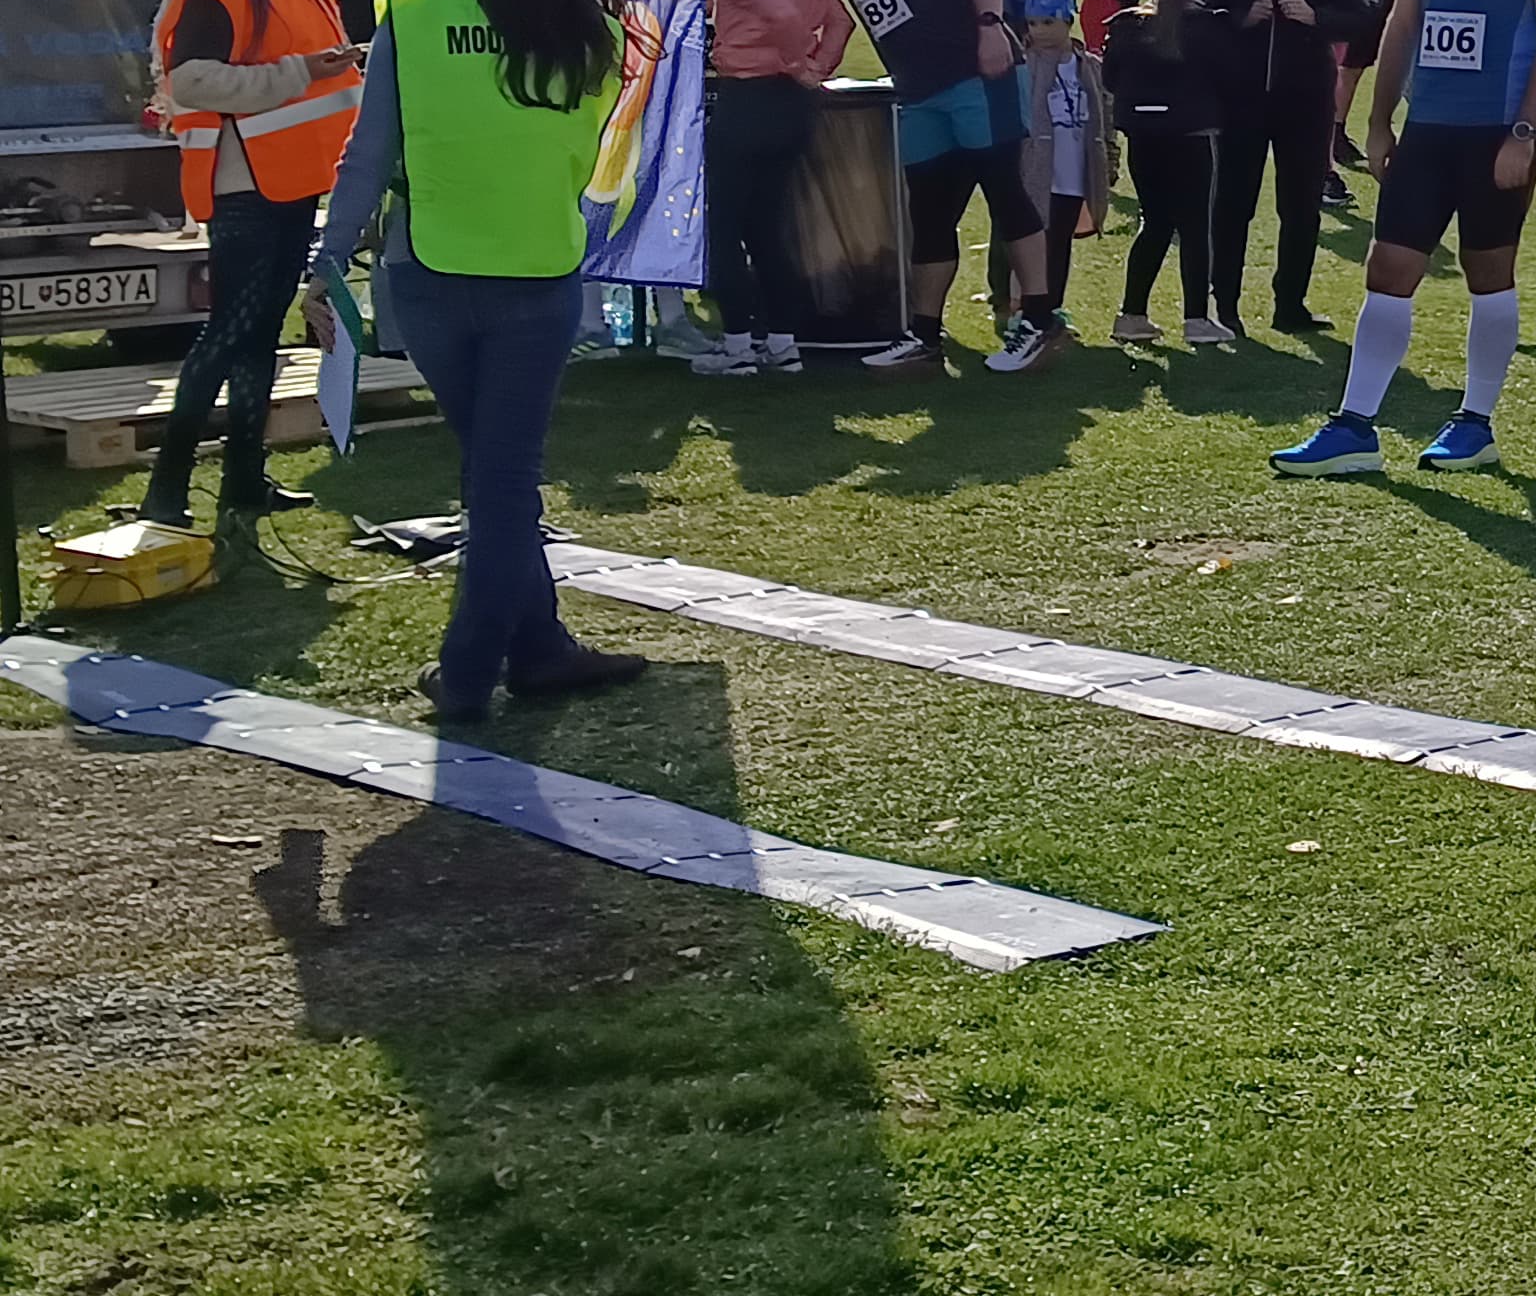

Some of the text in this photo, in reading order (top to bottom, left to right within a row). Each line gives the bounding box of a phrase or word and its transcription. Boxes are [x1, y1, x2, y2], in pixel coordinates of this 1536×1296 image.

[446, 25, 505, 54] MOD
[1424, 24, 1476, 54] 106
[0, 273, 151, 313] BL 583YA
